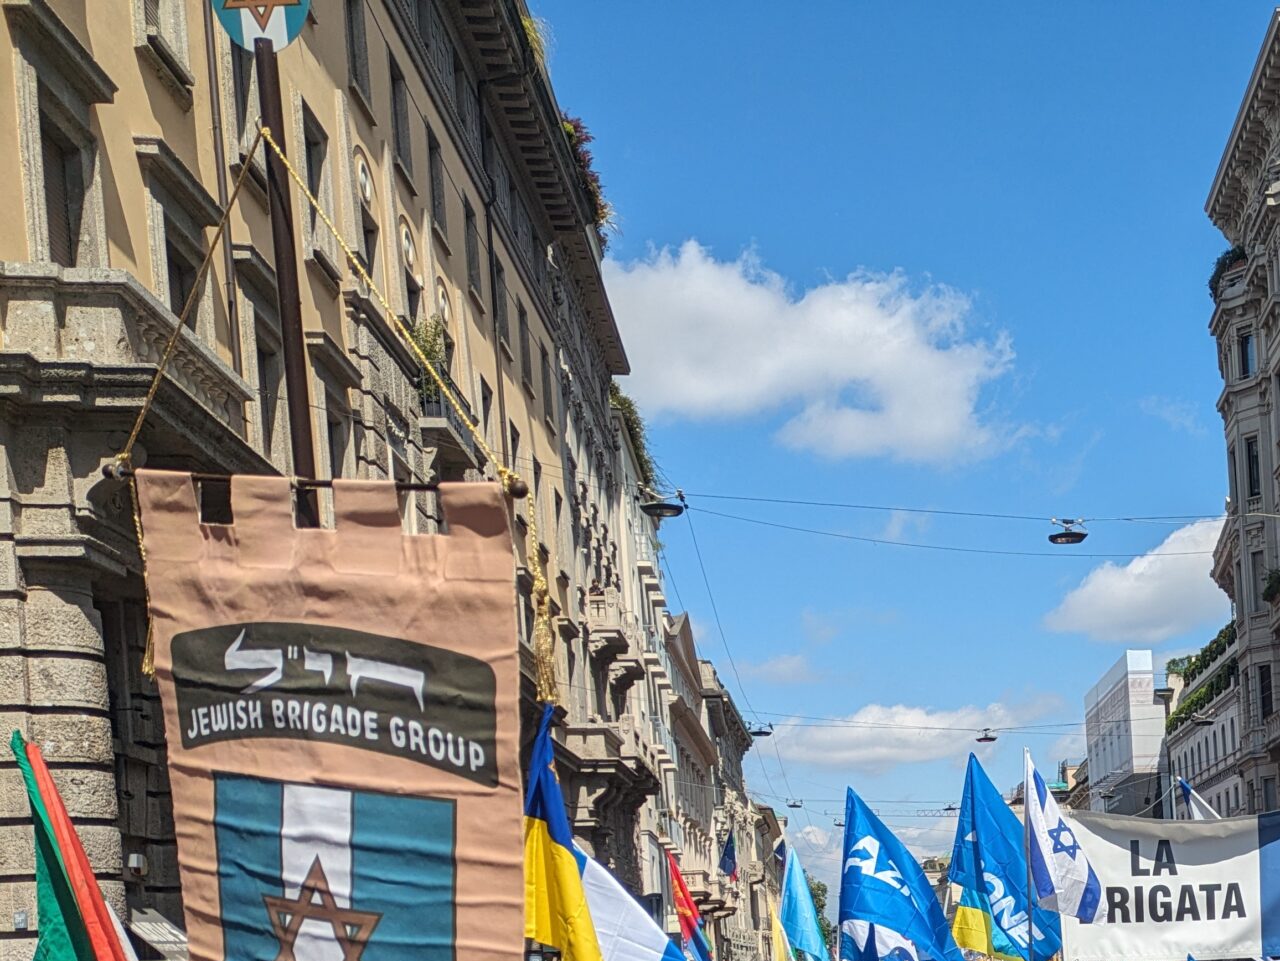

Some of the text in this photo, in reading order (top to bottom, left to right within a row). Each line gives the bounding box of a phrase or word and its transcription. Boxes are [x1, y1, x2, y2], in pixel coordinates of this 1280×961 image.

[187, 699, 486, 771] JEWISH BRIGADE GROUP
[1130, 839, 1178, 877] LA
[1079, 882, 1247, 925] RIGATA
